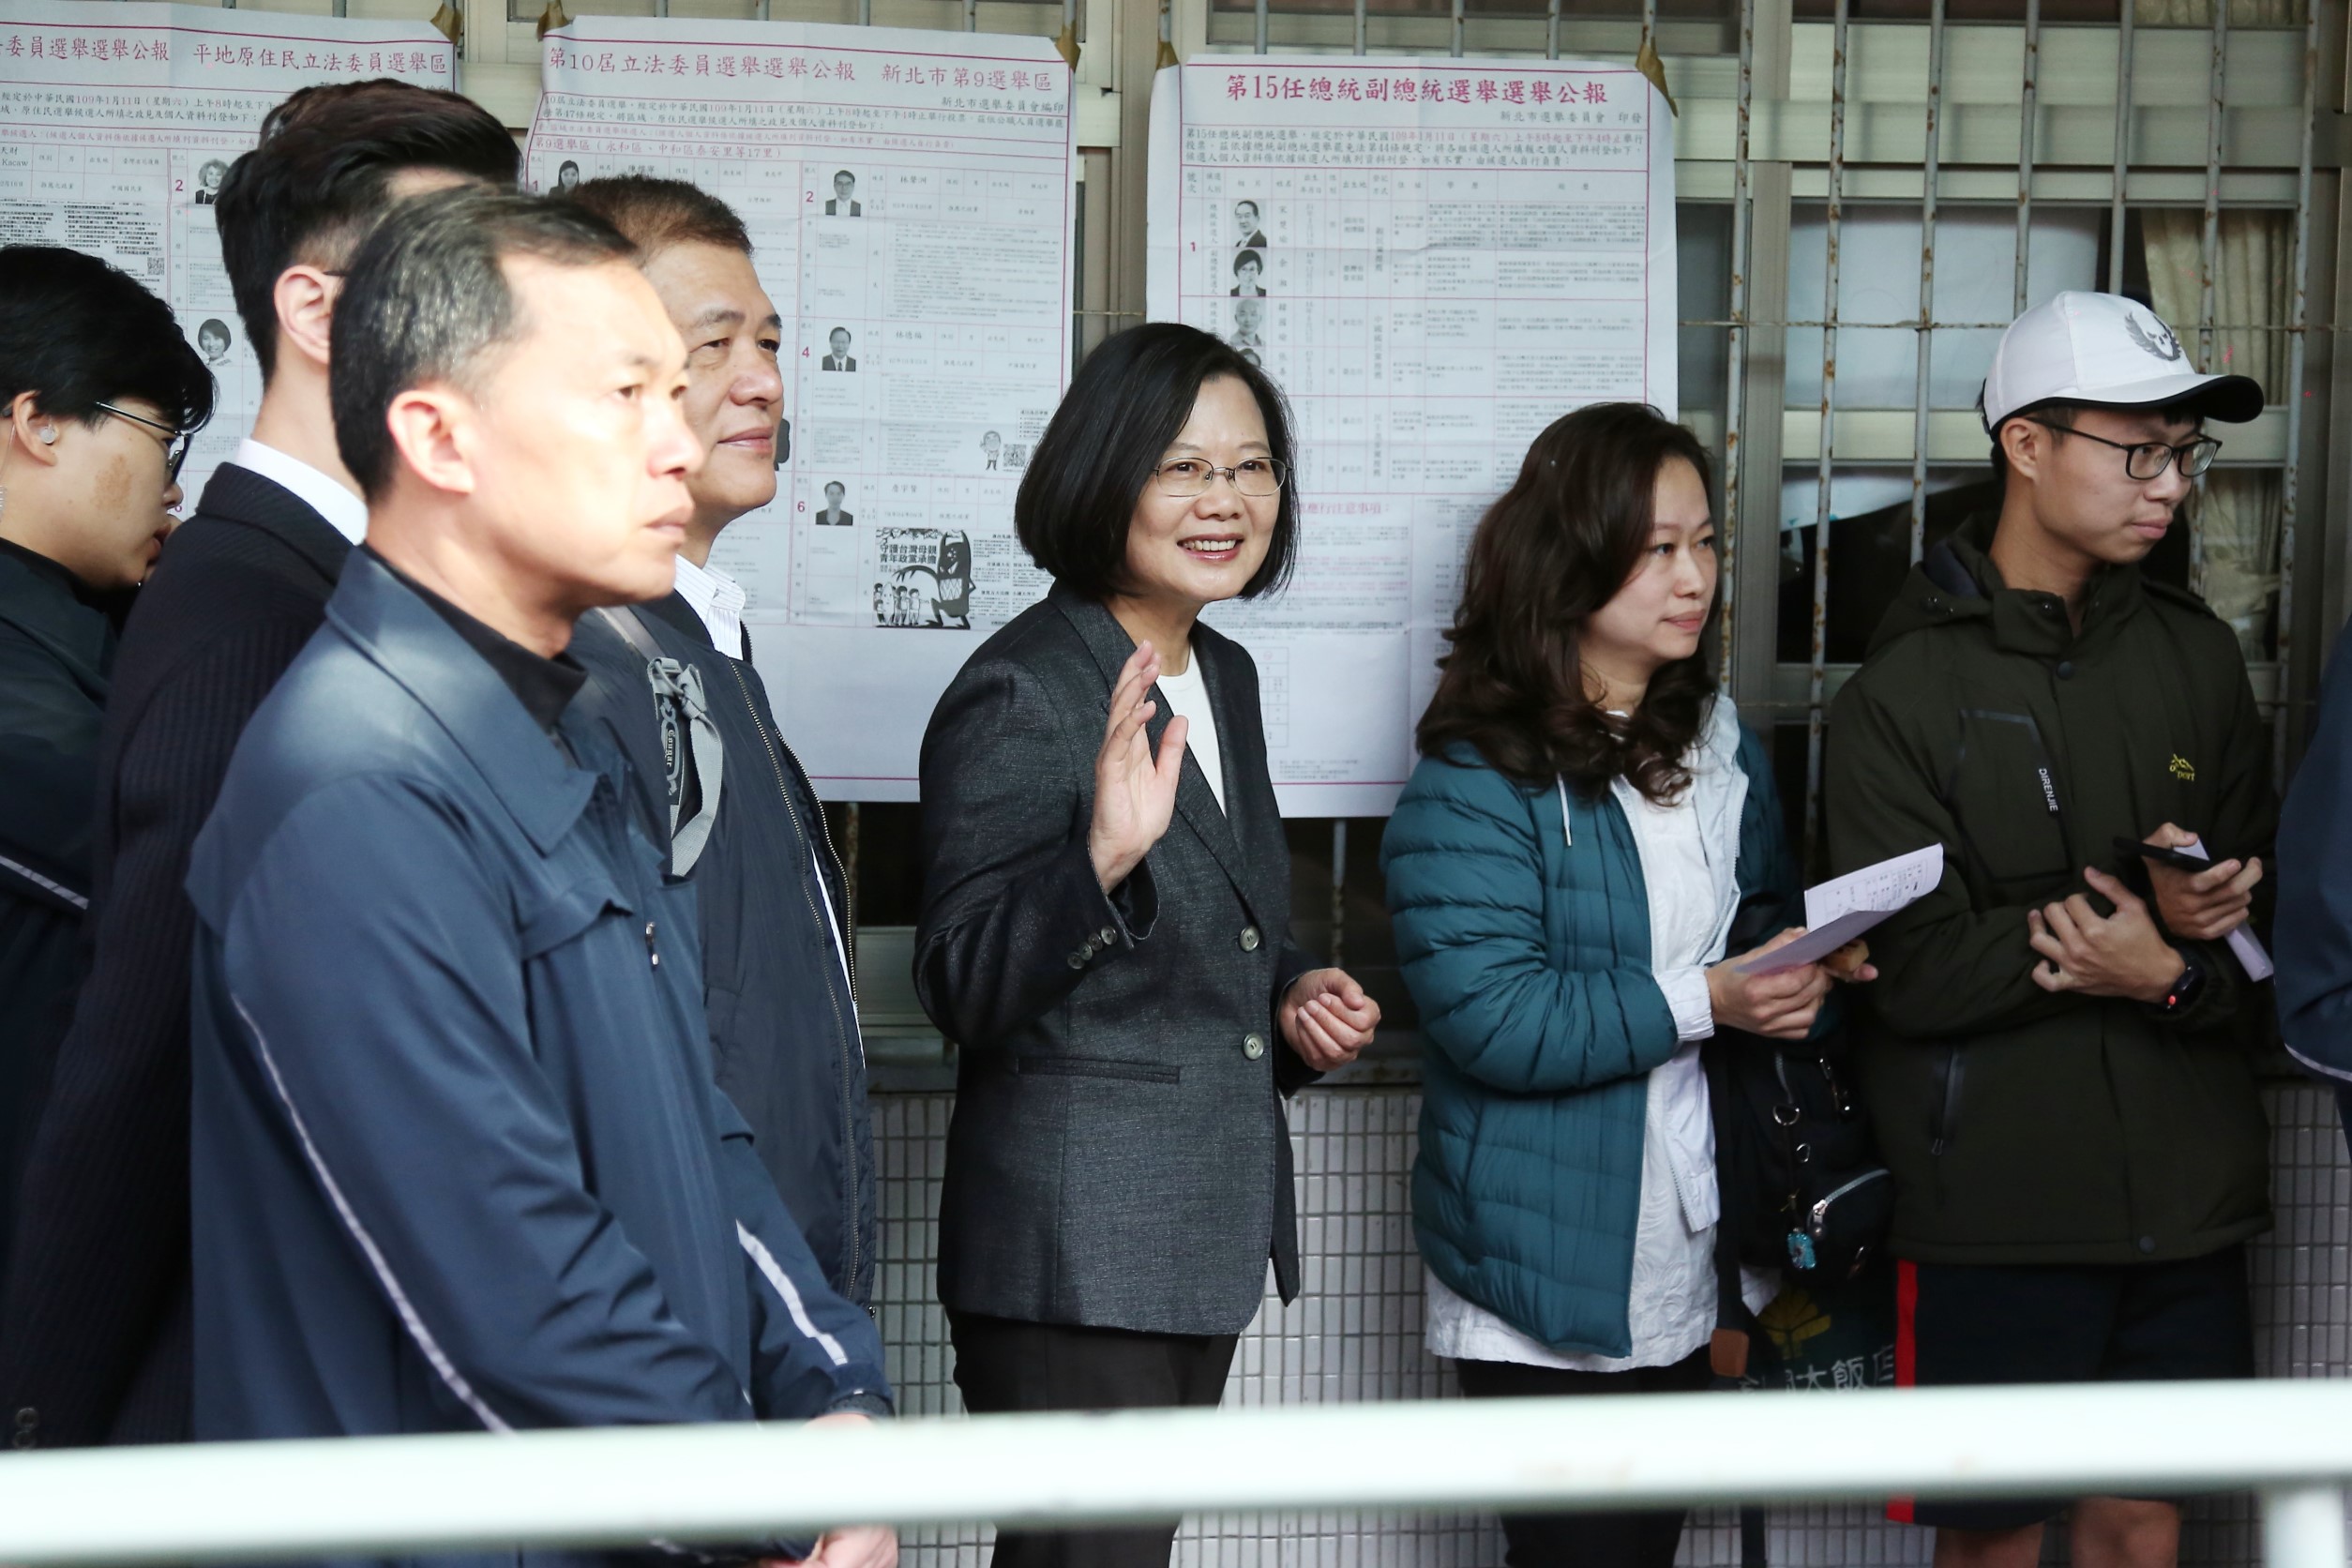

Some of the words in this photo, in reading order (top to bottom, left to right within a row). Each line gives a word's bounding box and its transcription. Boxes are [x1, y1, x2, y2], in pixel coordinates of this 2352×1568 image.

[0, 35, 170, 62] 委員選舉選舉公報
[192, 43, 447, 74] 平地原住民立法委員選舉區
[549, 47, 855, 82] 第10屆立法委員選舉選舉公報
[882, 64, 1052, 91] 新北市第9選舉區
[1226, 74, 1608, 105] 第15任總統副總統選舉選舉公報
[175, 179, 184, 192] 2
[532, 179, 539, 192] 1
[806, 190, 814, 203] 2
[1190, 241, 1196, 252] 1
[802, 347, 809, 358] 4
[797, 501, 806, 513] 6
[666, 730, 675, 767] Cougar
